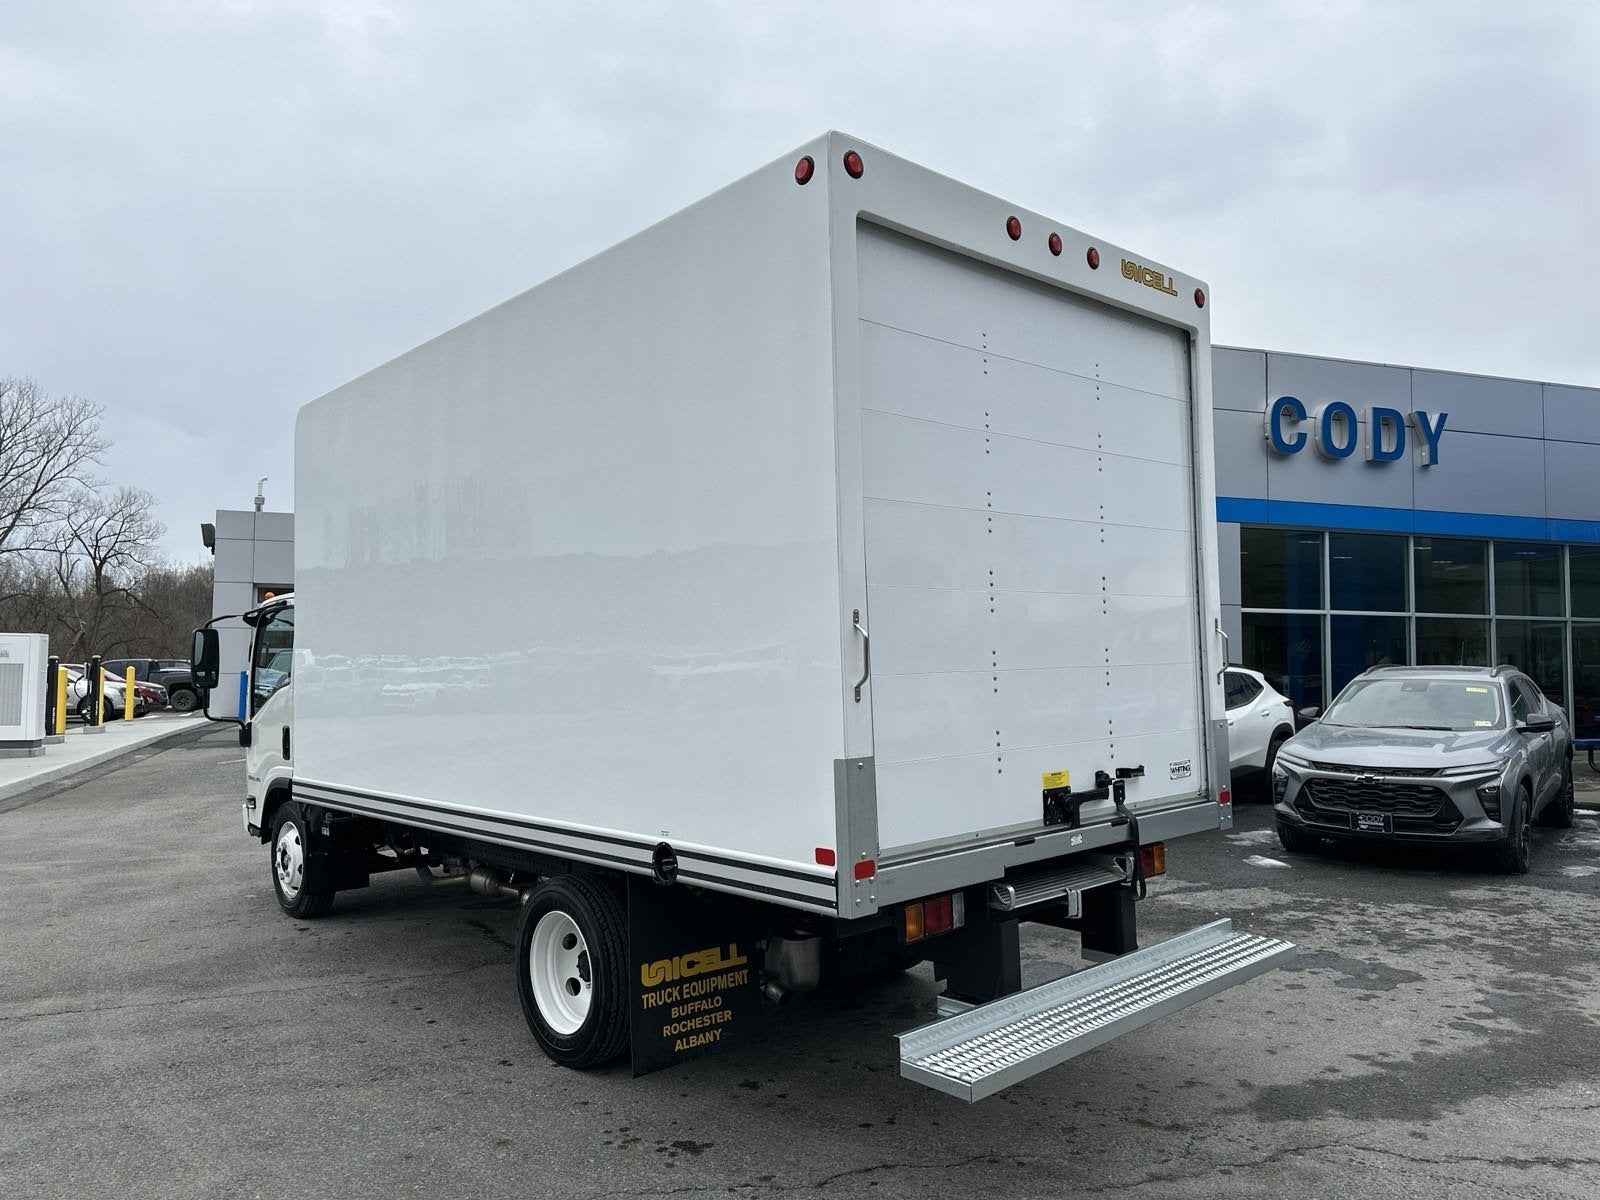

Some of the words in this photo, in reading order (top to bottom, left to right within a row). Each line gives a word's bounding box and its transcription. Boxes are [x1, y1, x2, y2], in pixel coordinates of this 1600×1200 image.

[1121, 259, 1177, 296] UNICELL
[1265, 396, 1448, 466] CODY
[641, 943, 748, 987] UNICELL
[642, 985, 681, 1009] TRUCK
[682, 969, 749, 999] EQUIPMENT
[671, 996, 722, 1018] BUFFALO
[663, 1010, 732, 1037] ROCHESTER
[674, 1029, 722, 1052] ALBANY
